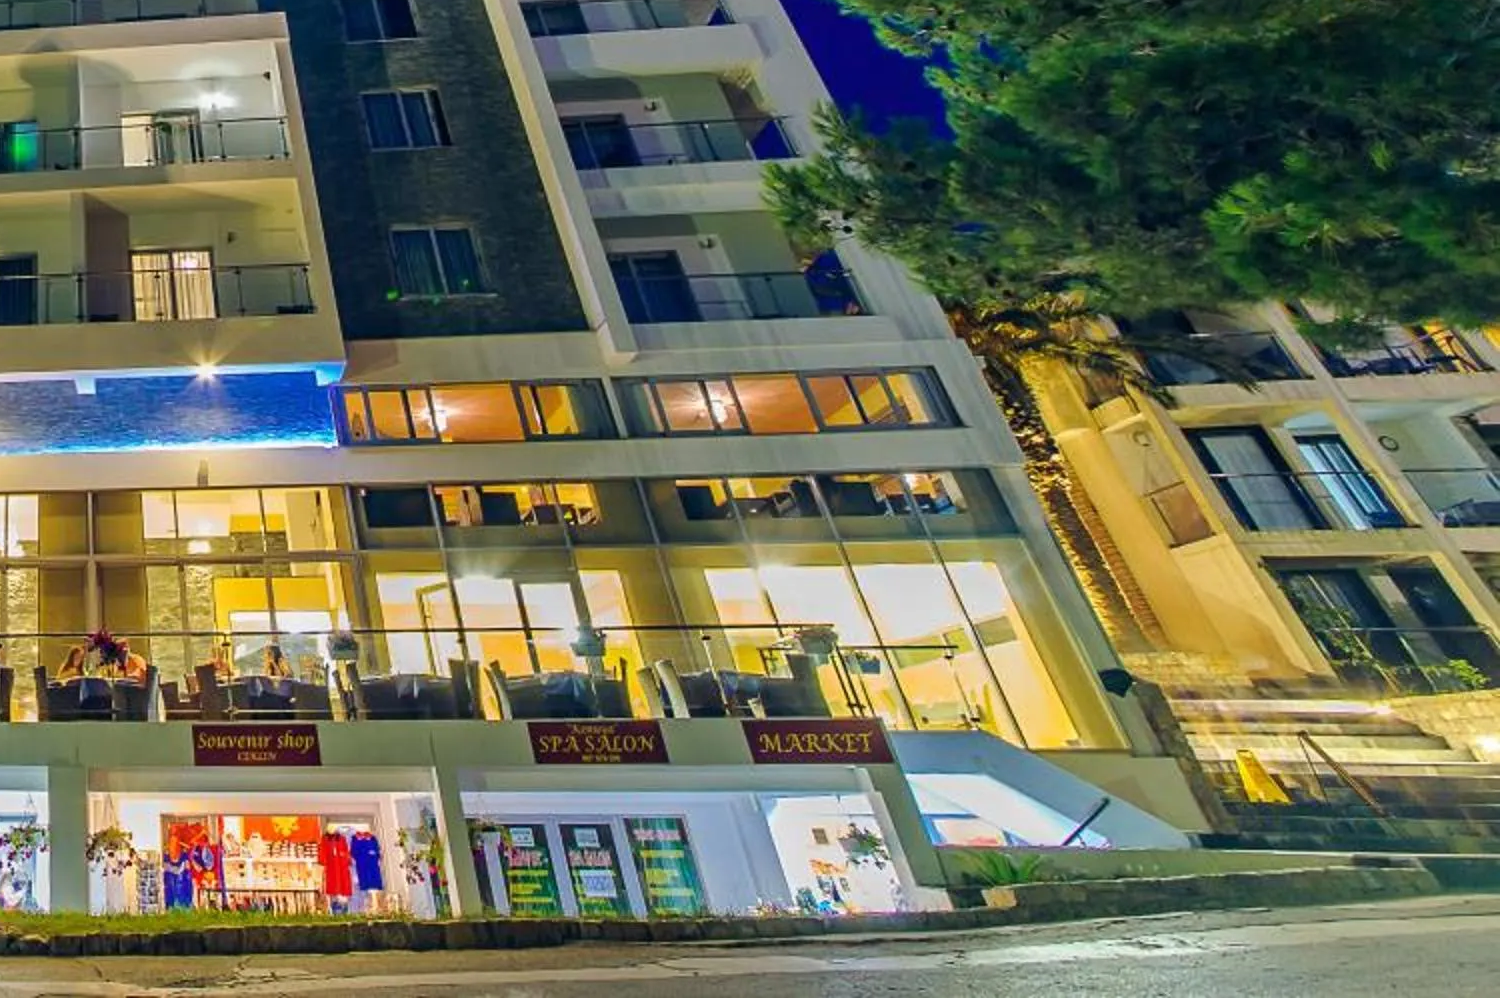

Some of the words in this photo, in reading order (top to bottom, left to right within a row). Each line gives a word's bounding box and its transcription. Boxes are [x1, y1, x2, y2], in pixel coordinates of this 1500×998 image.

[198, 731, 272, 749] Souvenir
[277, 730, 315, 754] shop
[539, 734, 581, 753] SPA
[584, 733, 656, 753] SALON
[759, 730, 874, 754] MARKET
